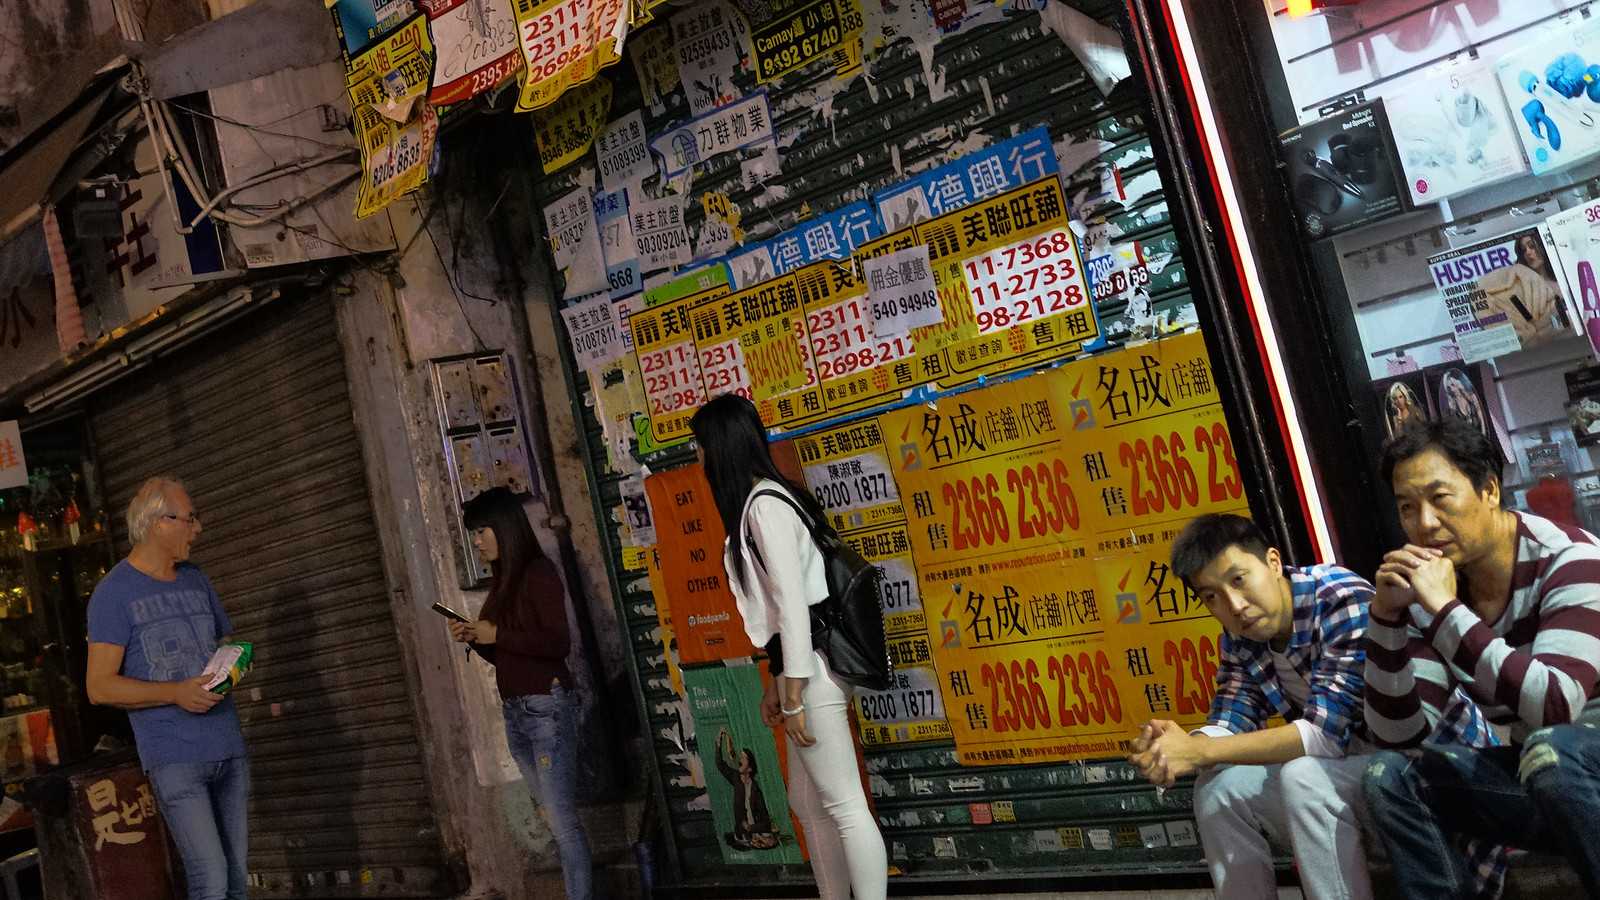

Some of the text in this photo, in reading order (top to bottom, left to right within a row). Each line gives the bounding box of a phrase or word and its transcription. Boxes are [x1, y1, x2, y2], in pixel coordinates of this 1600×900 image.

[757, 29, 793, 53] Camay
[802, 26, 838, 57] 6740
[472, 62, 503, 94] 2395
[698, 104, 766, 152] 力群物業
[636, 225, 688, 256] 90309204
[608, 267, 633, 290] 668
[1433, 246, 1513, 288] HUSTLER
[873, 289, 938, 321] 540 94948
[1449, 305, 1470, 319] PUSSY
[1118, 421, 1243, 517] 2366 23
[675, 490, 695, 507] EAT
[853, 472, 888, 503] 1877
[942, 457, 1080, 551] 2366 2336
[682, 519, 703, 536] LIKE
[689, 548, 706, 564] NO
[687, 575, 721, 594] OTHER
[1163, 634, 1222, 716] 236
[860, 689, 936, 721] 8200 1877
[980, 650, 1123, 733] 2366 2336
